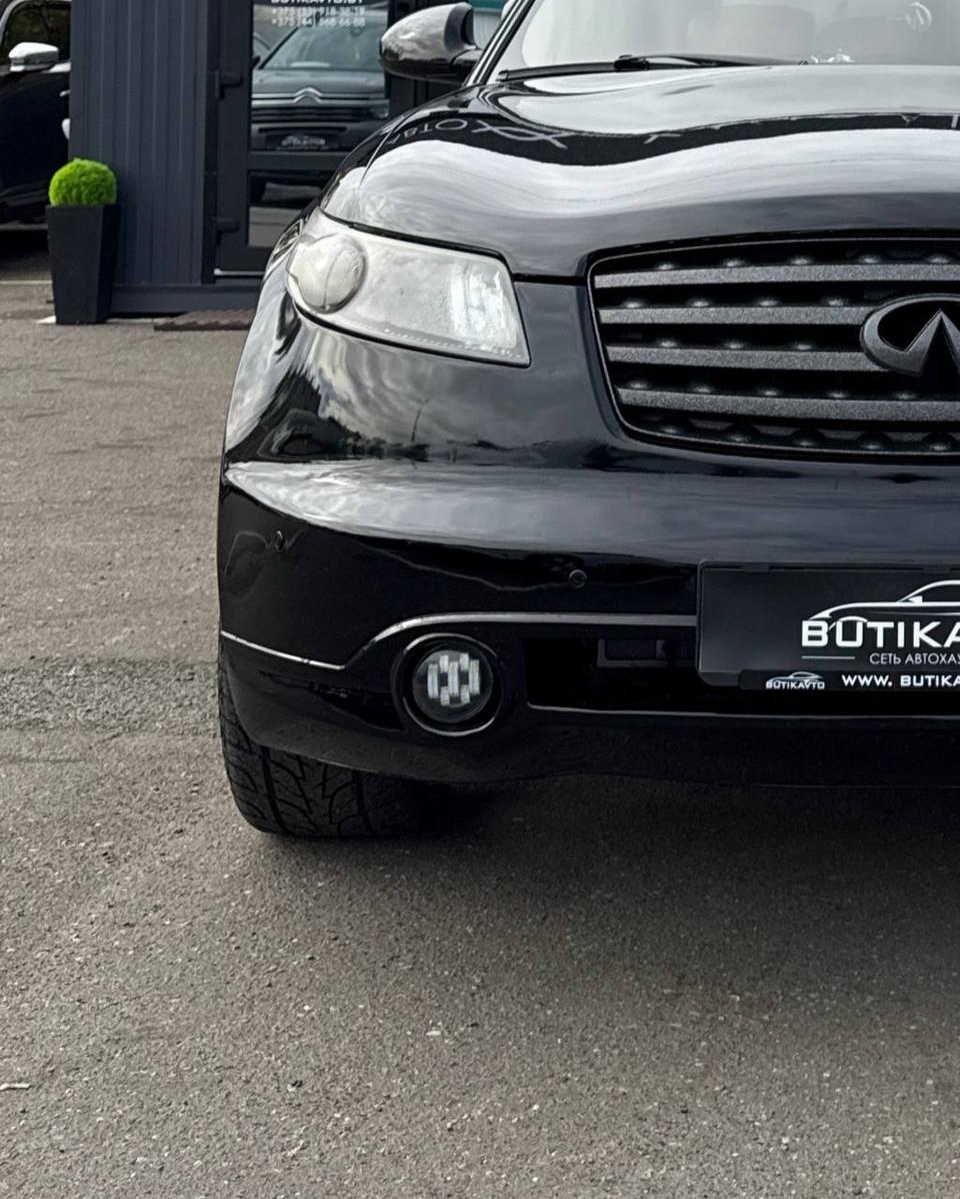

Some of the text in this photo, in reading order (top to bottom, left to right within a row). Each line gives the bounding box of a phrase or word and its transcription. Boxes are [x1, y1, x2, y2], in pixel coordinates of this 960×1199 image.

[869, 653, 901, 666] СЕТЬ
[766, 680, 825, 690] BUTIKAVTO
[841, 674, 892, 688] WWW.
